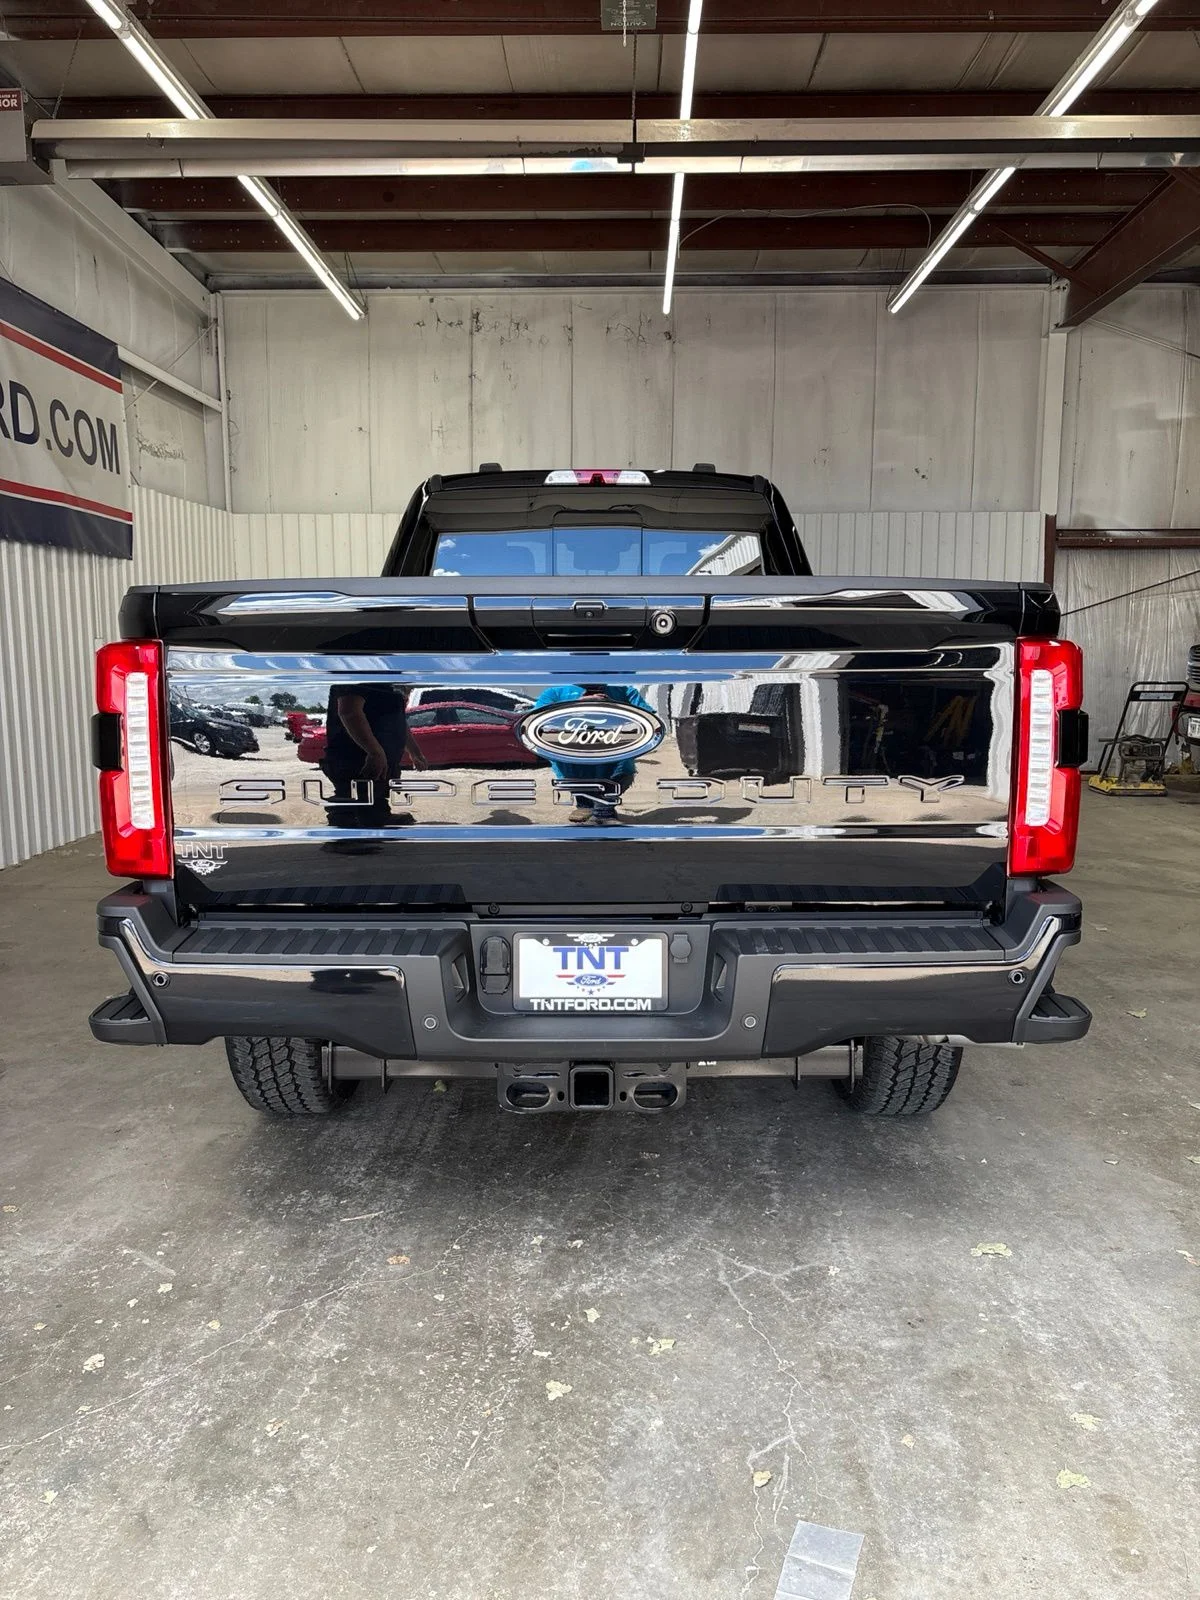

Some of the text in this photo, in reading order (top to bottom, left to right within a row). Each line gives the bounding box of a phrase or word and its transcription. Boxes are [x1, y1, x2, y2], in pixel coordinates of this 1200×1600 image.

[0, 98, 18, 107] OR
[557, 717, 624, 745] Ford
[220, 775, 965, 806] SUPER DUTY
[175, 841, 229, 859] TNT
[552, 946, 630, 970] TNT
[580, 975, 602, 985] Ford
[529, 998, 652, 1011] TNTFORD.COM
